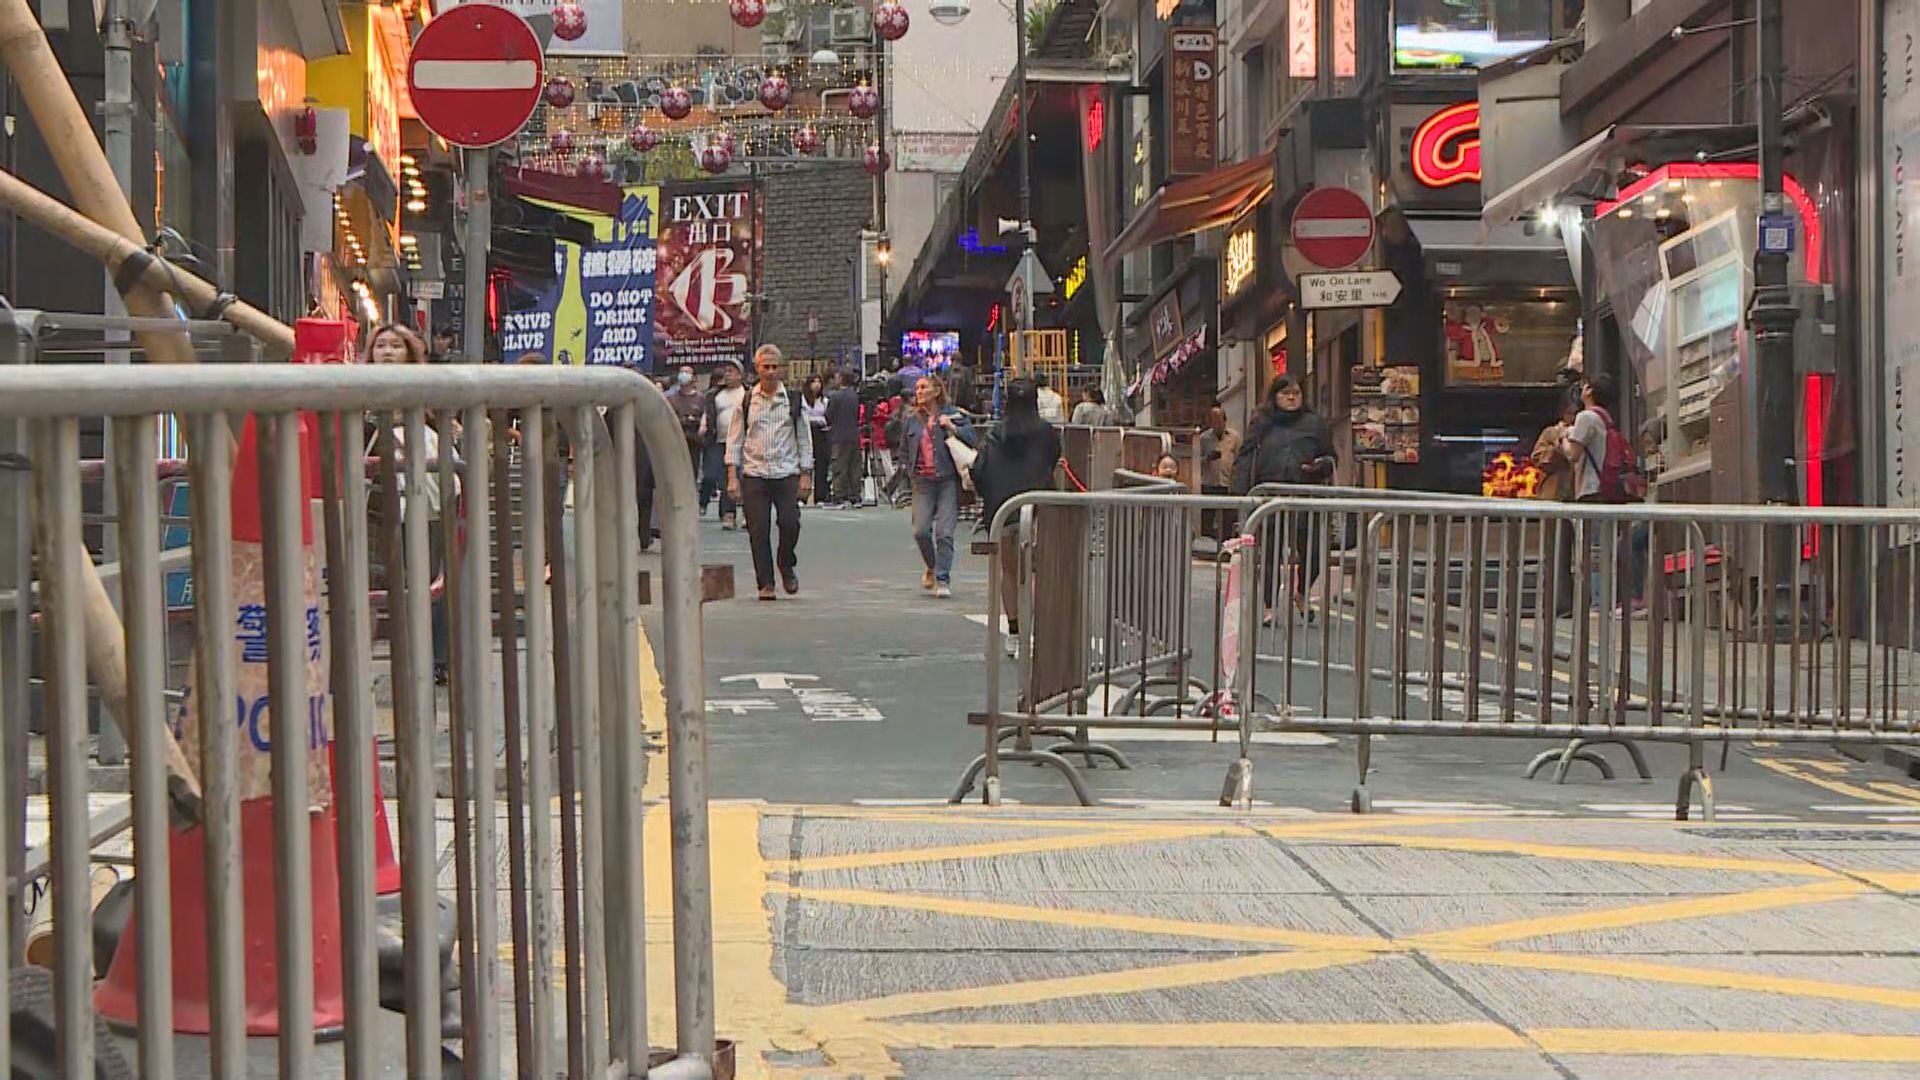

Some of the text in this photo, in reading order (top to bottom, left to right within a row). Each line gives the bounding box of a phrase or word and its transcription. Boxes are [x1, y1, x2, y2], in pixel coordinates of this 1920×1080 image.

[673, 192, 748, 221] EXIT
[689, 221, 731, 245] 出口
[1309, 276, 1372, 287] Wo On Lane
[590, 288, 652, 308] DO NOT
[1319, 288, 1362, 302] 和安里
[594, 307, 646, 326] DRINK
[601, 327, 637, 343] AND
[593, 345, 644, 363] DRIVE
